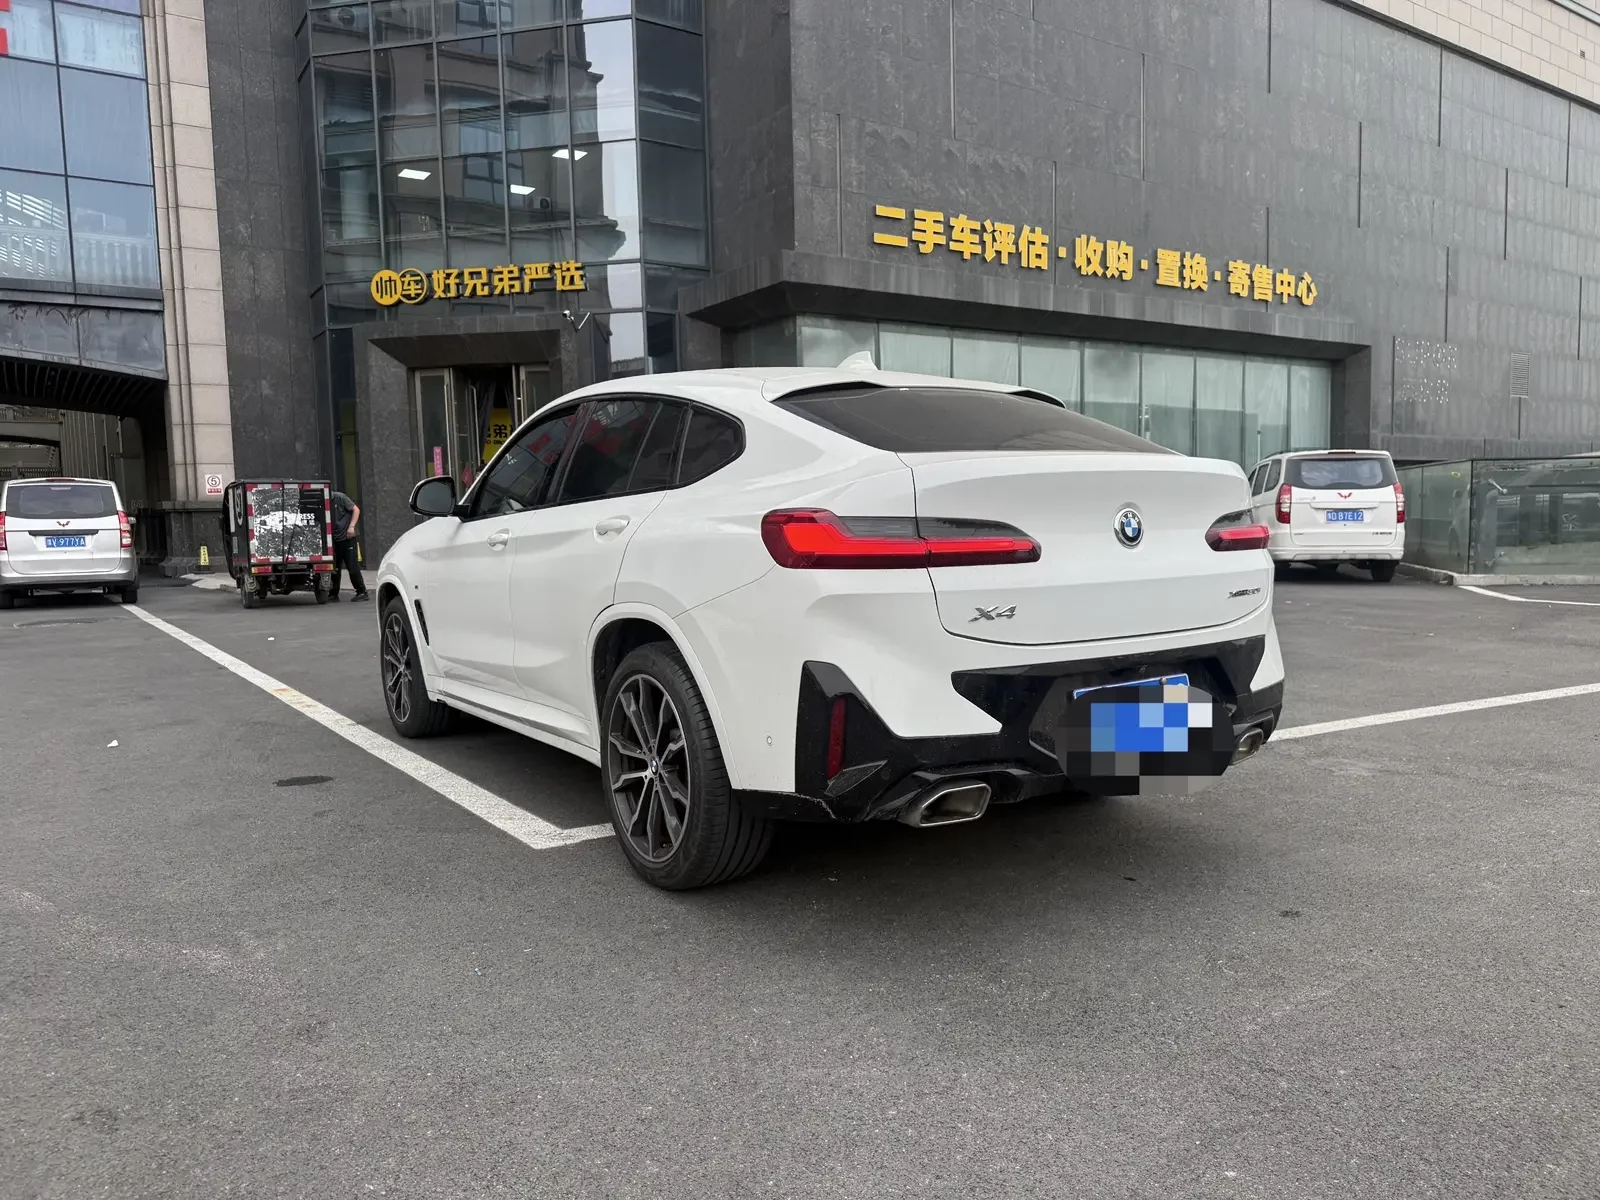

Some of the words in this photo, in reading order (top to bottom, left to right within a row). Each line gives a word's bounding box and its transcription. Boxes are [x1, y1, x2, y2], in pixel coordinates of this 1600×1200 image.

[432, 260, 587, 299] 好兄弟严选
[968, 604, 1017, 623] X4
